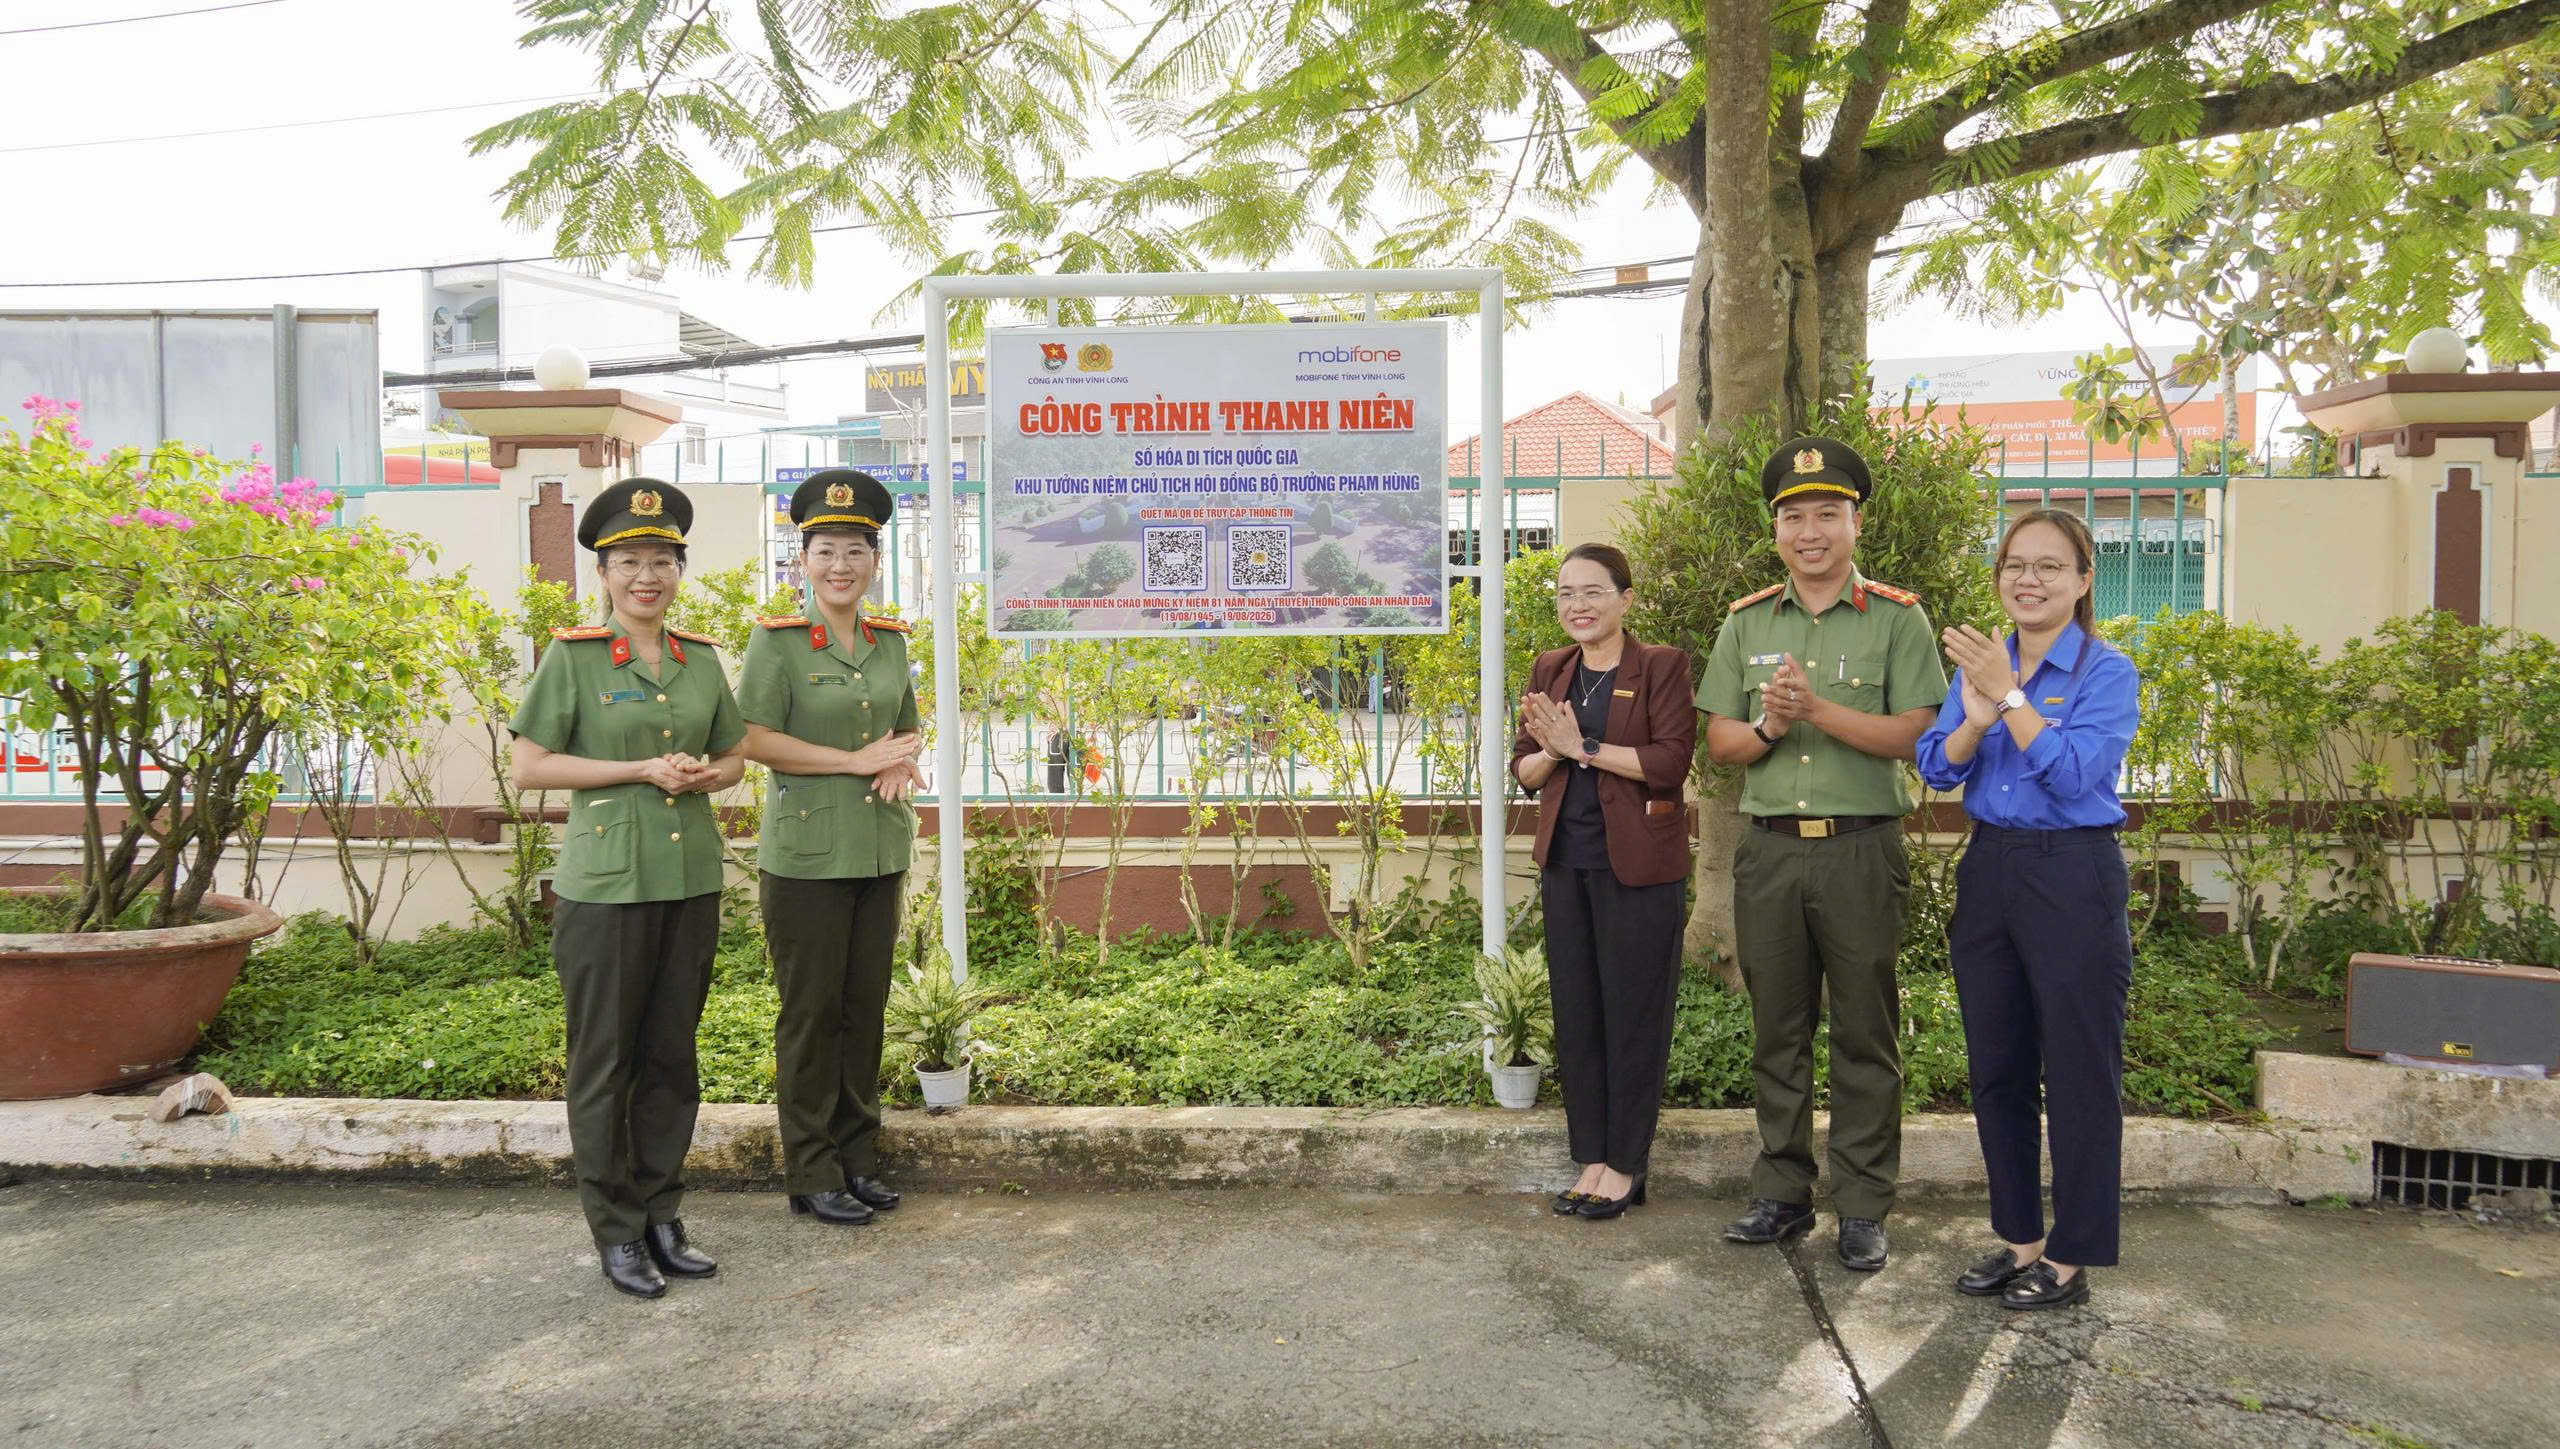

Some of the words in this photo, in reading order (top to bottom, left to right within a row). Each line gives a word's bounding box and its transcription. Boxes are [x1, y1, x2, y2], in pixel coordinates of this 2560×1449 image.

[1299, 346, 1401, 362] mobifone
[896, 363, 927, 387] THẤ
[1028, 375, 1050, 384] CÔNG
[1107, 376, 1128, 384] LONG
[1295, 373, 1339, 381] MOBIFONE
[1020, 395, 1101, 433] CÔNG
[1110, 393, 1210, 432] TRÌNH
[1219, 401, 1329, 431] THANH
[1339, 392, 1414, 430] NIÊN
[1135, 444, 1151, 466] SỐ
[1156, 447, 1183, 466] HÓA
[1187, 450, 1199, 465] DI
[1203, 446, 1232, 465] TÍCH
[1236, 444, 1272, 467] QUỐC
[1276, 449, 1298, 465] GIA
[1015, 479, 1042, 494] KHU
[1045, 473, 1089, 494] TƯỞNG
[1093, 474, 1128, 497] NIỆM
[1131, 471, 1157, 493] CHỦ
[1161, 477, 1191, 496] TỊCH
[1194, 474, 1216, 496] HỘI
[1220, 471, 1257, 493] ĐỒNG
[1260, 473, 1278, 495] BỘ
[1282, 471, 1335, 492] TRƯỞNG
[1339, 475, 1378, 495] PHẠM
[1383, 471, 1420, 491] HÙNG
[1180, 508, 1191, 519] QR
[1193, 504, 1204, 518] ĐỂ
[1206, 508, 1227, 518] TRUY
[1229, 506, 1246, 520] CẬP
[1249, 506, 1277, 518] THÔNG
[1280, 508, 1293, 517] TIN
[1005, 597, 1030, 608] CÔNG
[1032, 597, 1059, 608] TRÌNH
[1062, 599, 1090, 608] THANH
[1093, 597, 1114, 608] NIÊN
[1117, 597, 1140, 608] CHÀO
[1143, 596, 1170, 608] MỪNG
[1186, 596, 1209, 609] NIỆM
[1212, 599, 1221, 608] 81
[1311, 594, 1340, 607] THỐNG
[1343, 596, 1367, 607] CÔNG
[1369, 597, 1382, 606] AN
[1384, 596, 1409, 606] NHÂN
[1412, 596, 1431, 606] DÂN
[1160, 611, 1214, 622] (19/08/1945
[1223, 610, 1275, 622] 19/08/2026)
